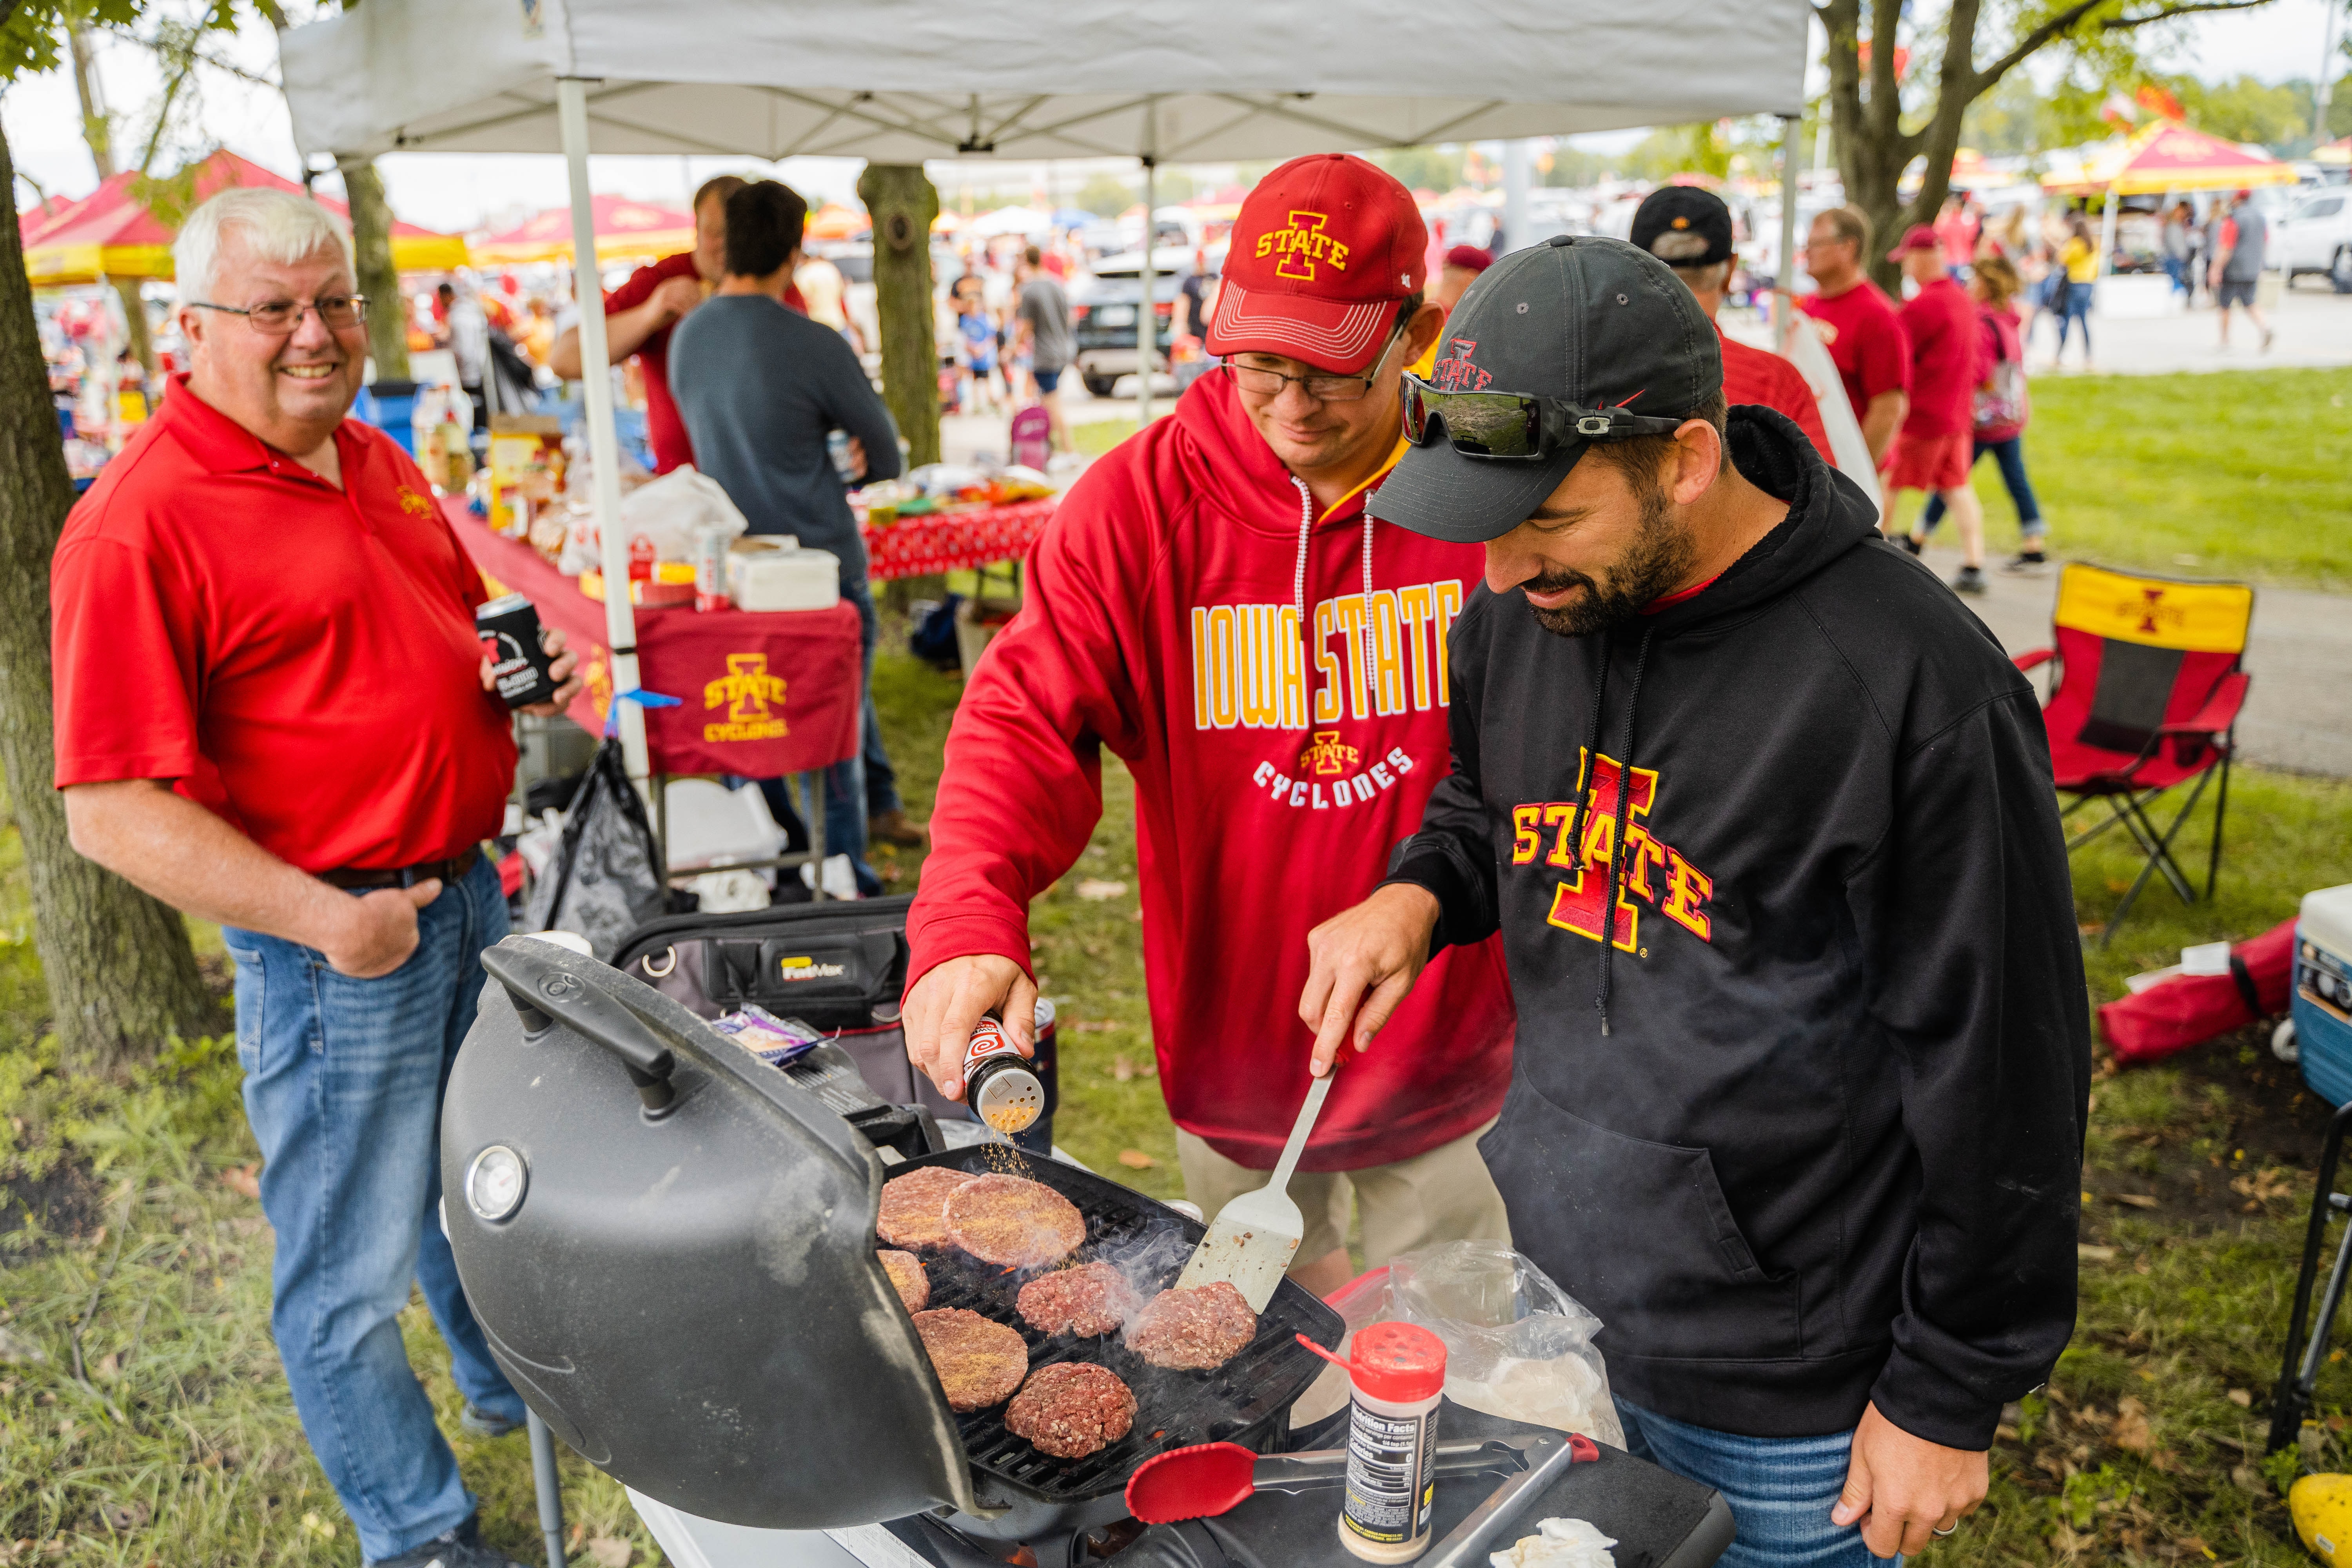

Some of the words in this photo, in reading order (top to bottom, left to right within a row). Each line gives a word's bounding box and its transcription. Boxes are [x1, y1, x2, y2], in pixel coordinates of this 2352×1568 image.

[1256, 229, 1349, 270] STATE
[1191, 604, 1308, 730] IOWA
[704, 673, 787, 710] STATE
[704, 718, 789, 742] CYCLONES
[1300, 744, 1359, 768] STATE
[1253, 746, 1414, 809] CYCLONES
[1512, 802, 1713, 944] STATE
[1352, 1404, 1385, 1431] Nutrition
[1387, 1423, 1415, 1433] Facts
[1350, 1437, 1374, 1459] Calories
[1406, 1453, 1412, 1463] 0
